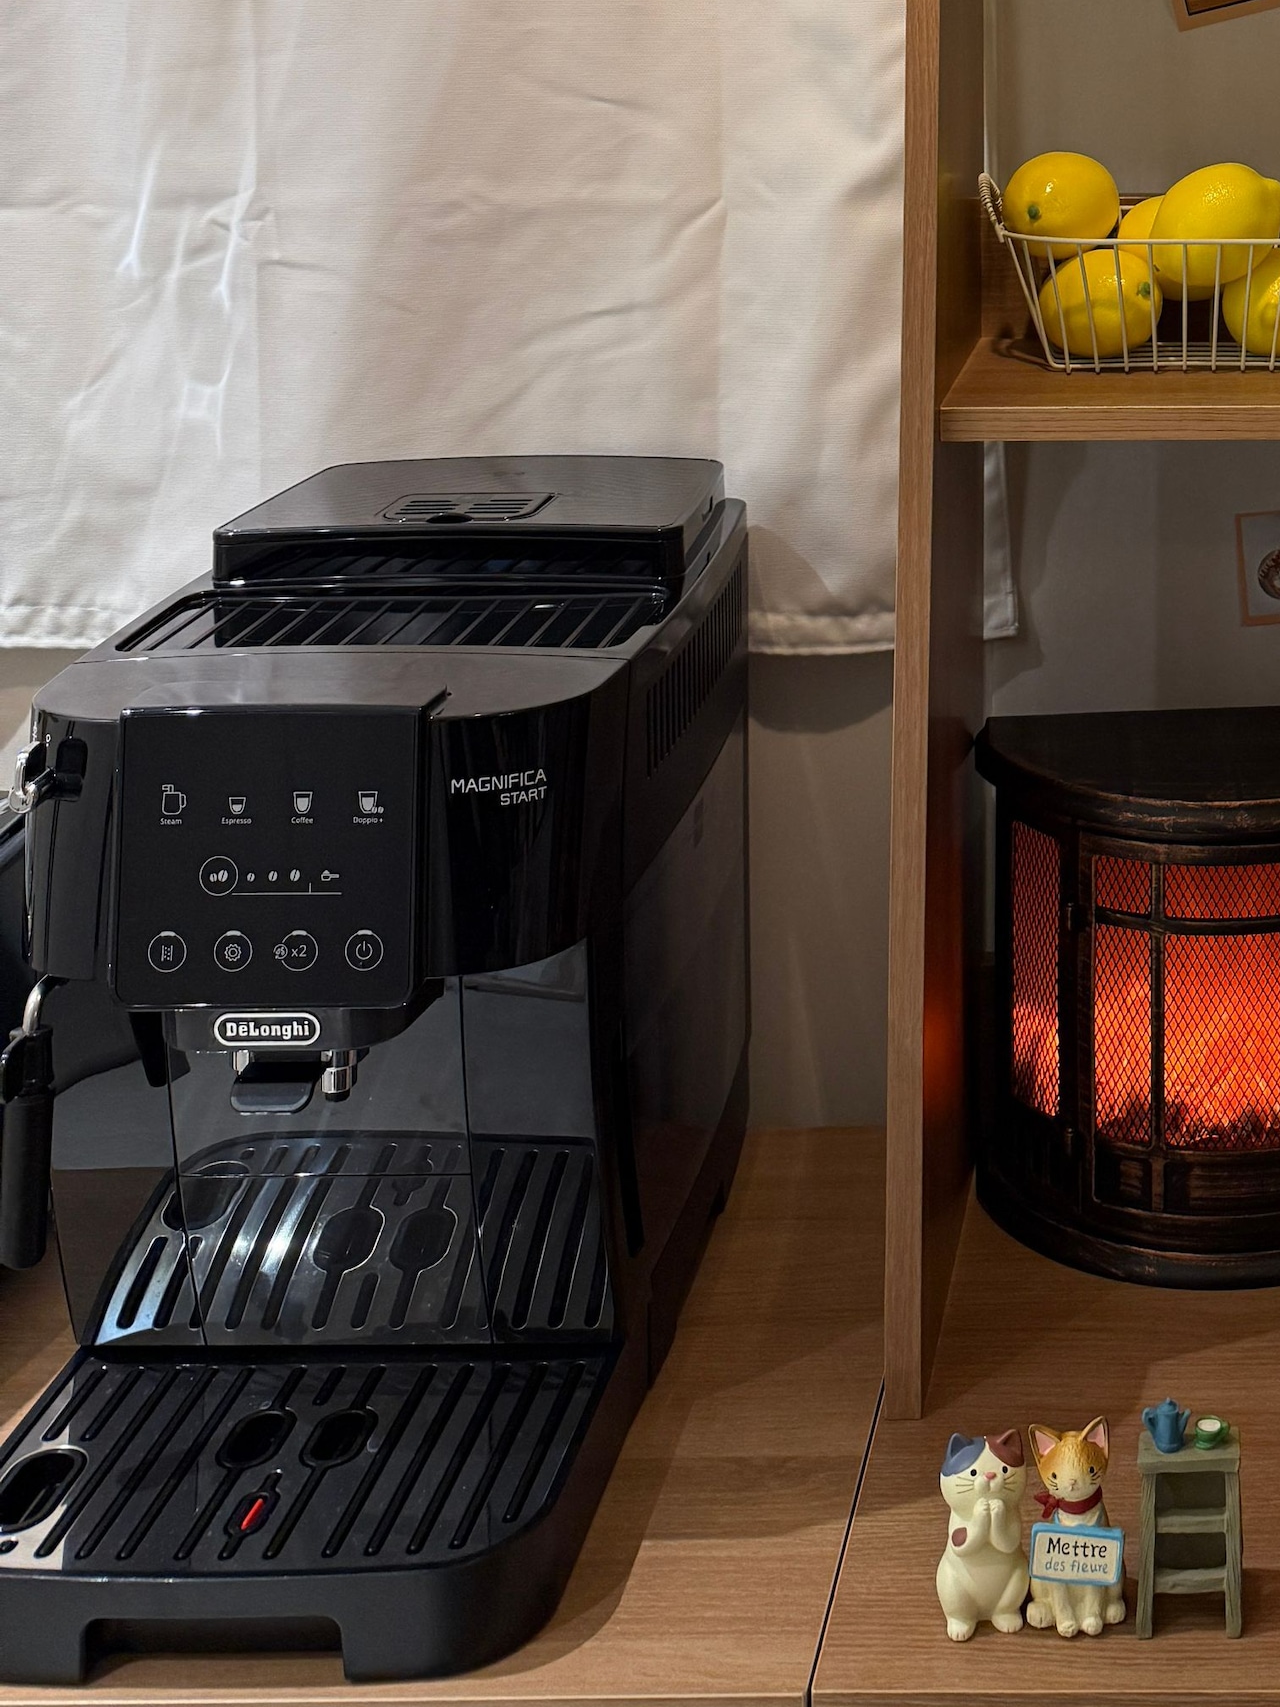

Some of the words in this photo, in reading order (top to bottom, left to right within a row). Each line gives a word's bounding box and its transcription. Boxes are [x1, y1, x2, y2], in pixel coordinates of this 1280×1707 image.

[451, 768, 547, 794] MAGNIFICA
[500, 786, 548, 806] START
[160, 817, 182, 825] Steam
[221, 817, 252, 826] Espresso
[291, 944, 307, 957] x2
[1046, 1537, 1107, 1558] Mettre
[1045, 1557, 1065, 1572] des
[1071, 1560, 1108, 1574] fleure
